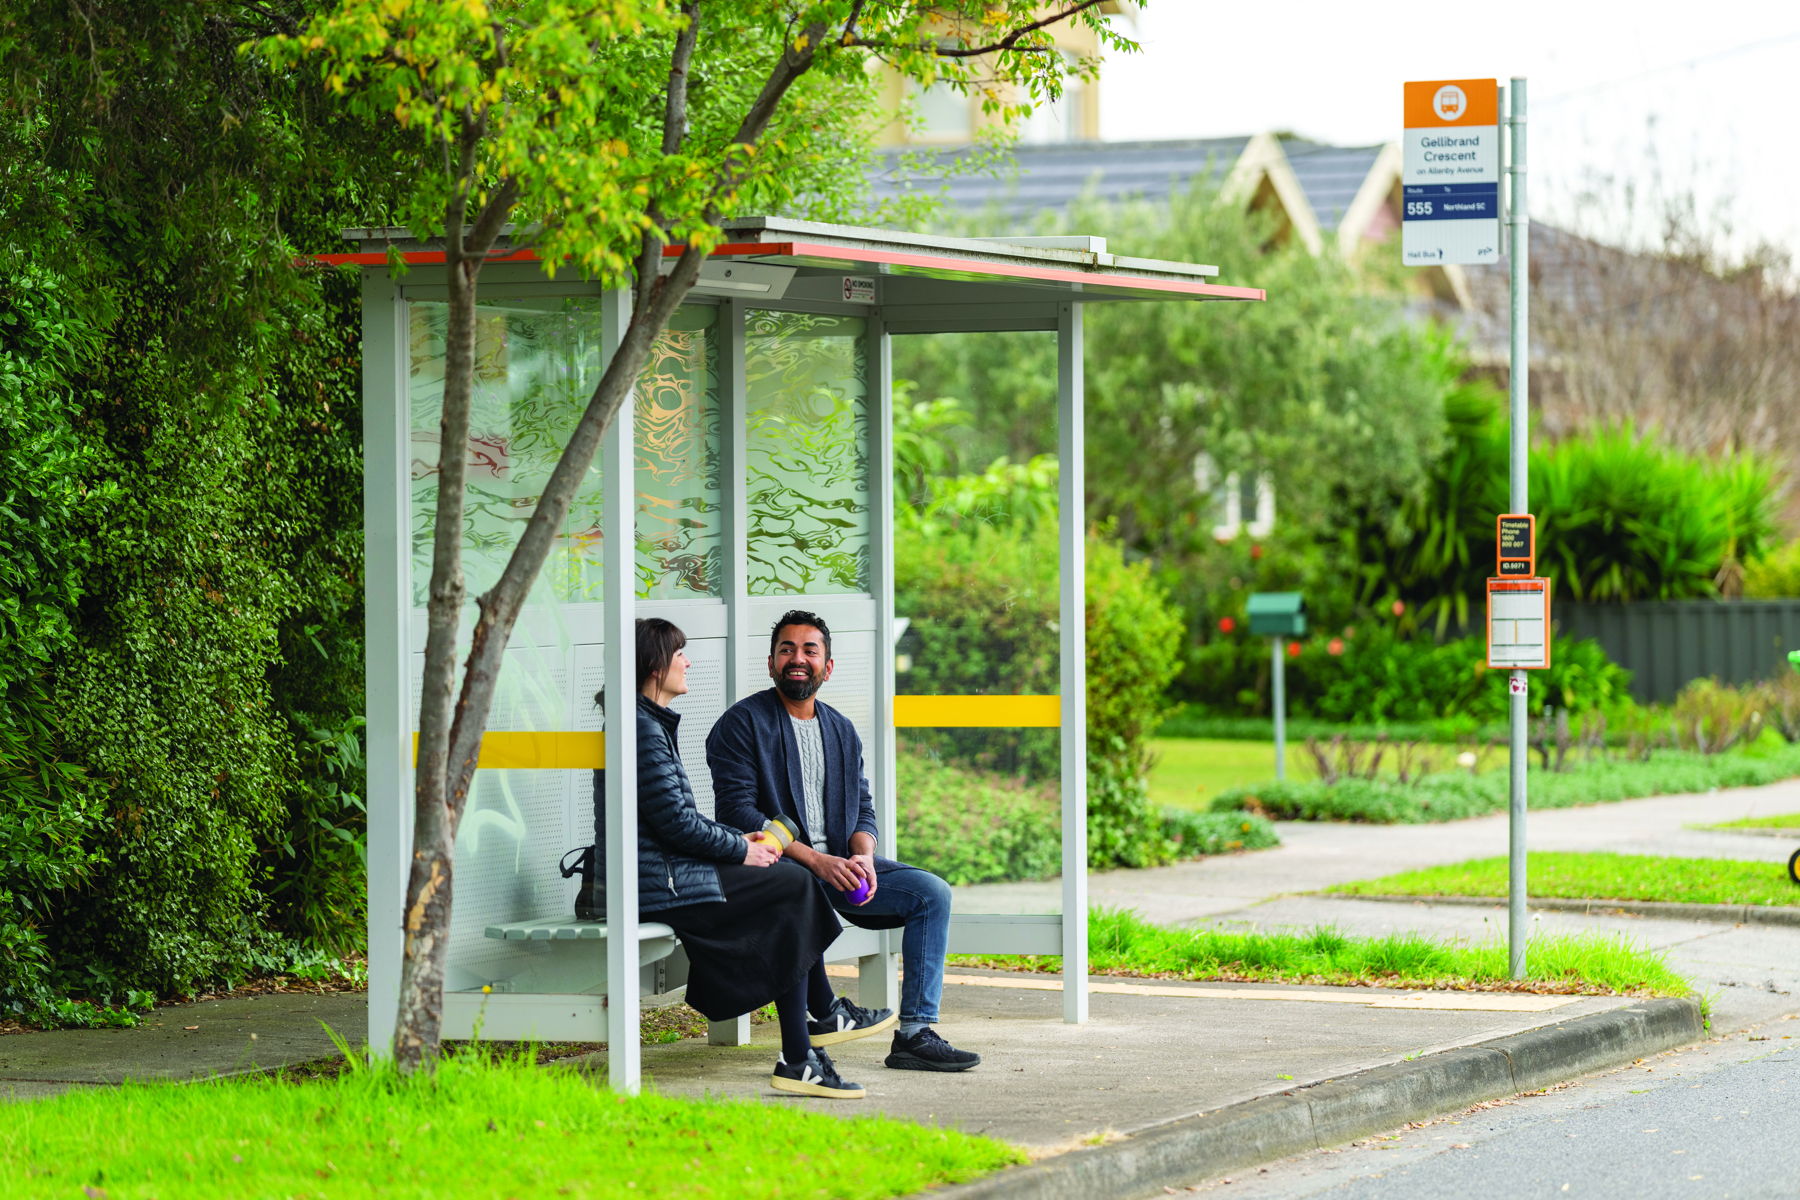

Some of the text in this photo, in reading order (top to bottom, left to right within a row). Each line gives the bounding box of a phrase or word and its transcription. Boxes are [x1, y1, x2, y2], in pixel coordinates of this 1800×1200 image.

[1421, 136, 1479, 147] Gellibrand
[1424, 151, 1476, 162] Crescent
[1407, 201, 1486, 215] 555 Northland SC
[1422, 250, 1435, 258] Bus
